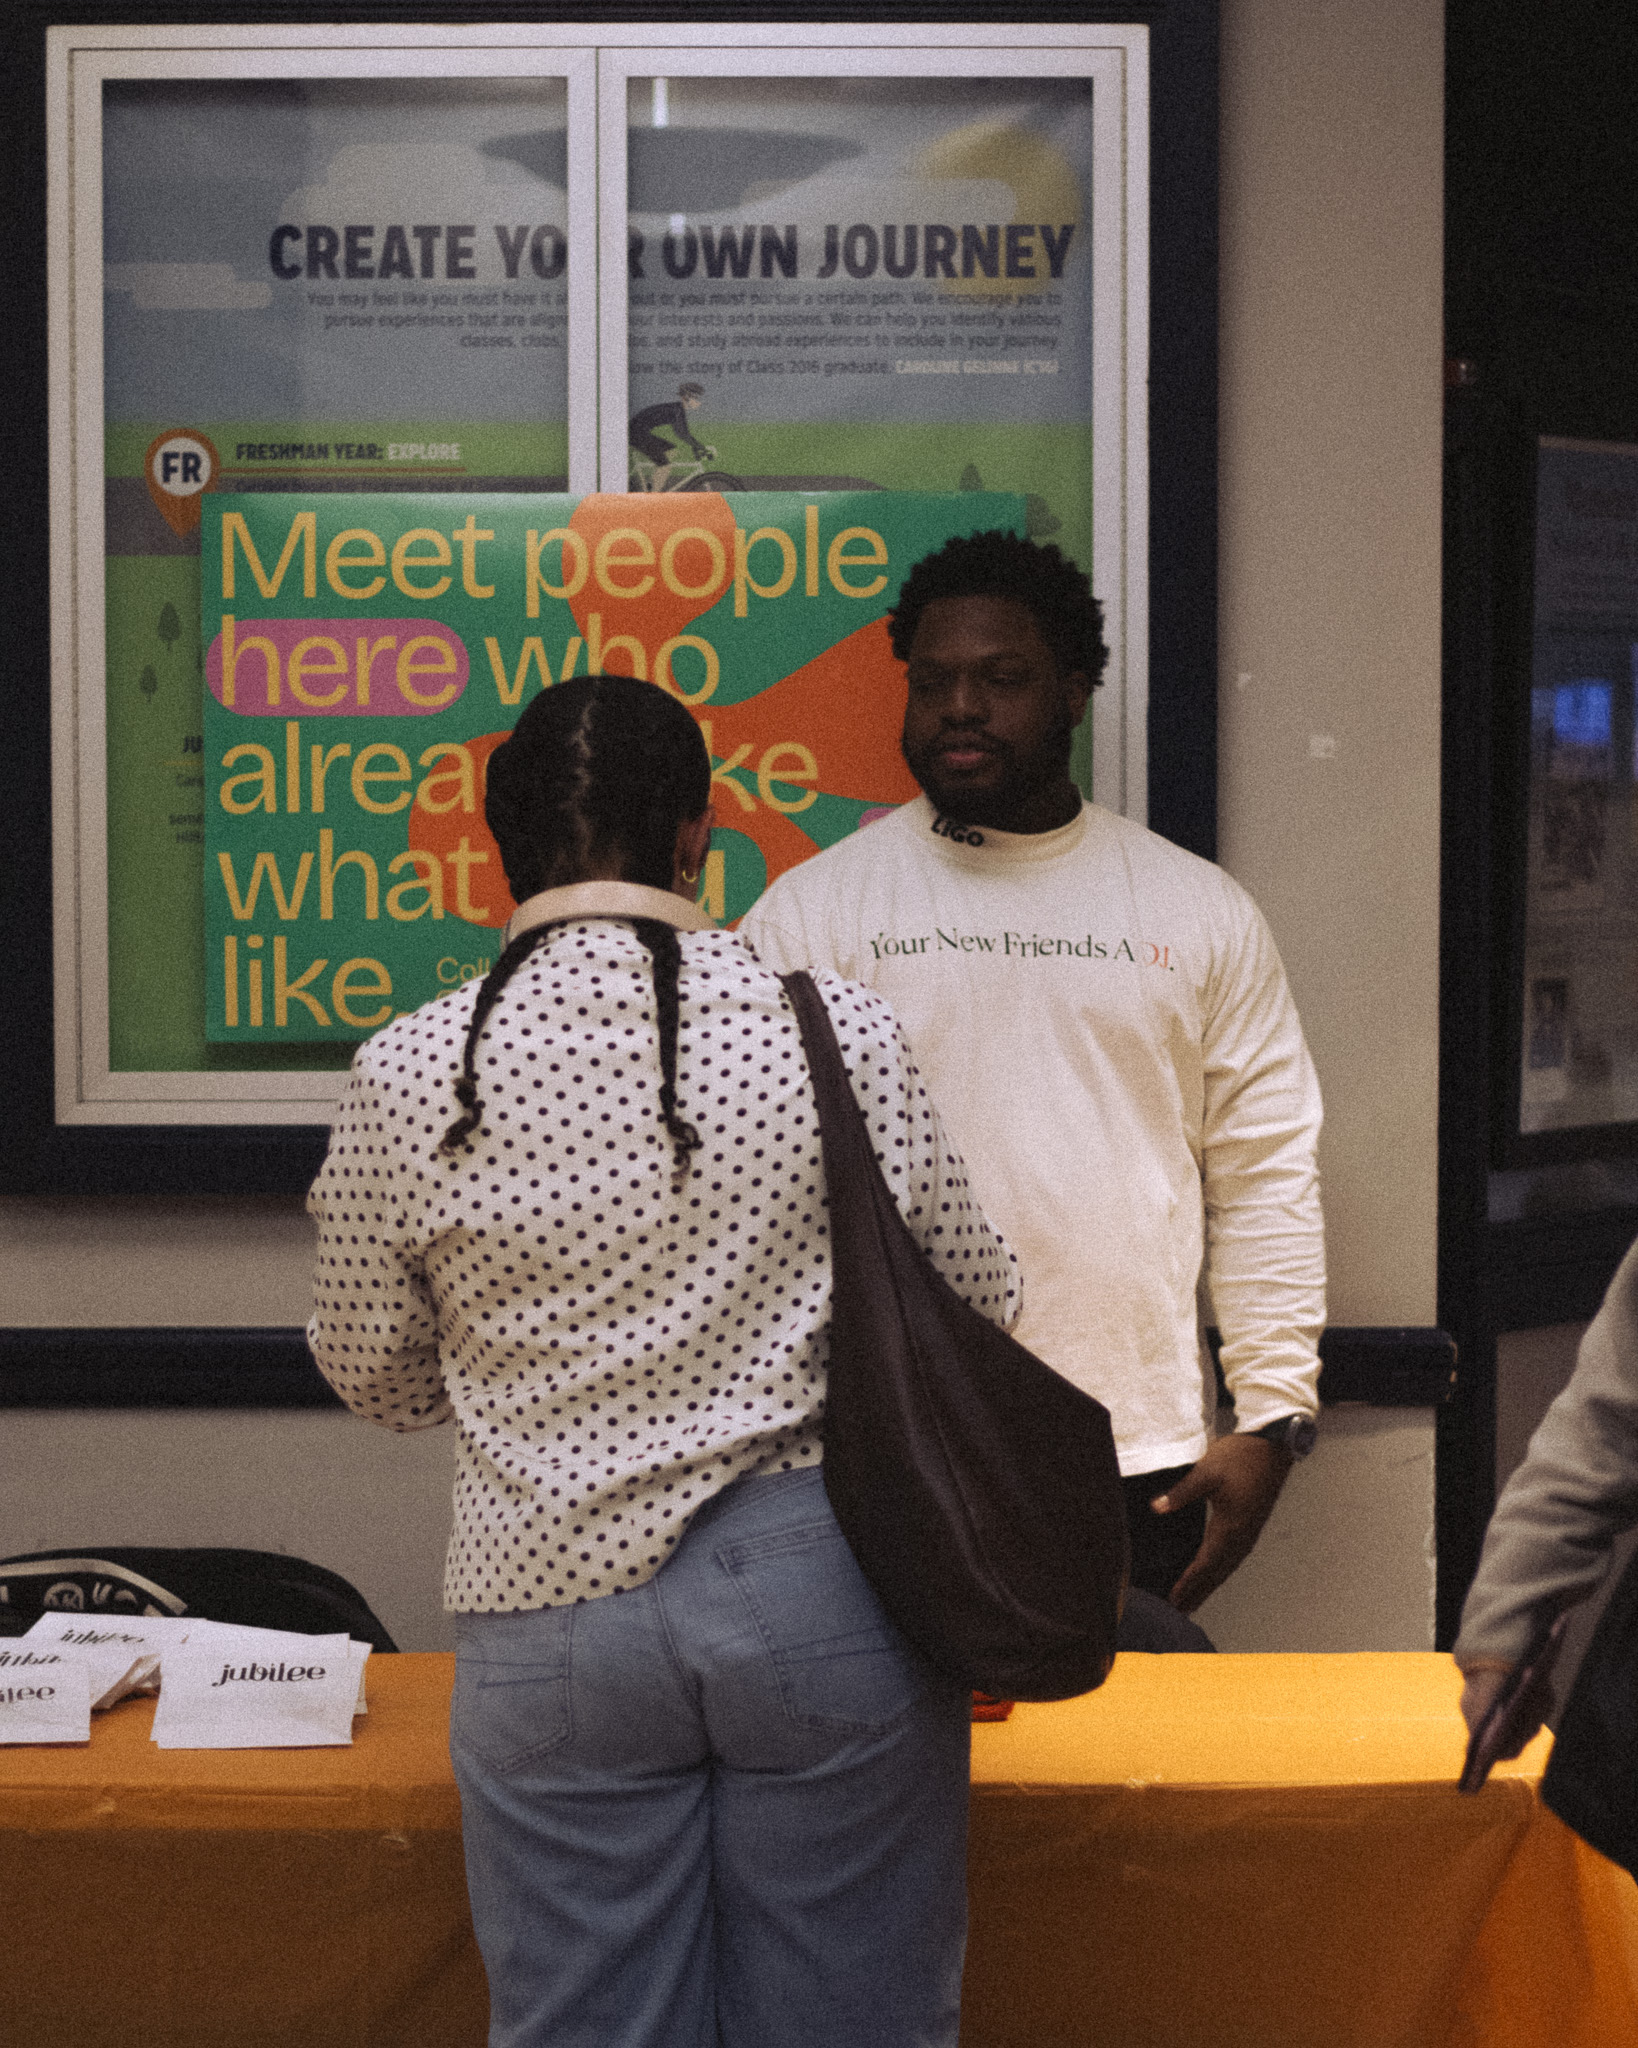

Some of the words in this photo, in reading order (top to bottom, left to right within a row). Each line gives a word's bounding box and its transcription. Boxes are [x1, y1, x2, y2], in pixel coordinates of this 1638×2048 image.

[269, 224, 476, 280] CREATE
[494, 224, 646, 280] YOR
[661, 225, 798, 280] OWN
[817, 224, 1076, 280] JOURNEY
[307, 292, 334, 305] You
[338, 295, 367, 309] may
[432, 295, 458, 309] you
[461, 293, 498, 305] must
[679, 295, 705, 309] you
[709, 292, 745, 305] must
[1016, 295, 1043, 309] you
[378, 314, 464, 330] experiences
[468, 313, 497, 326] that
[502, 316, 525, 326] are
[658, 313, 723, 326] interests
[728, 313, 754, 326] and
[855, 315, 882, 326] can
[886, 312, 917, 328] help
[920, 315, 946, 329] you
[687, 335, 726, 351] study
[732, 334, 781, 347] abroad
[785, 335, 870, 350] experiences
[687, 361, 723, 378] story
[747, 360, 785, 374] Class
[162, 451, 201, 484] FR
[236, 443, 330, 460] FRESHMAN
[334, 443, 385, 460] YEAR:
[388, 443, 461, 460] EXPLORE
[221, 511, 495, 600] Meet
[526, 505, 890, 618] people
[221, 614, 458, 707] here
[484, 612, 720, 707] who
[219, 721, 489, 815] alrea
[700, 720, 819, 813] ke
[217, 828, 489, 921] what
[869, 932, 931, 960] Your
[936, 927, 997, 951] New
[1004, 931, 1108, 959] Friends
[211, 1662, 327, 1687] jubilee
